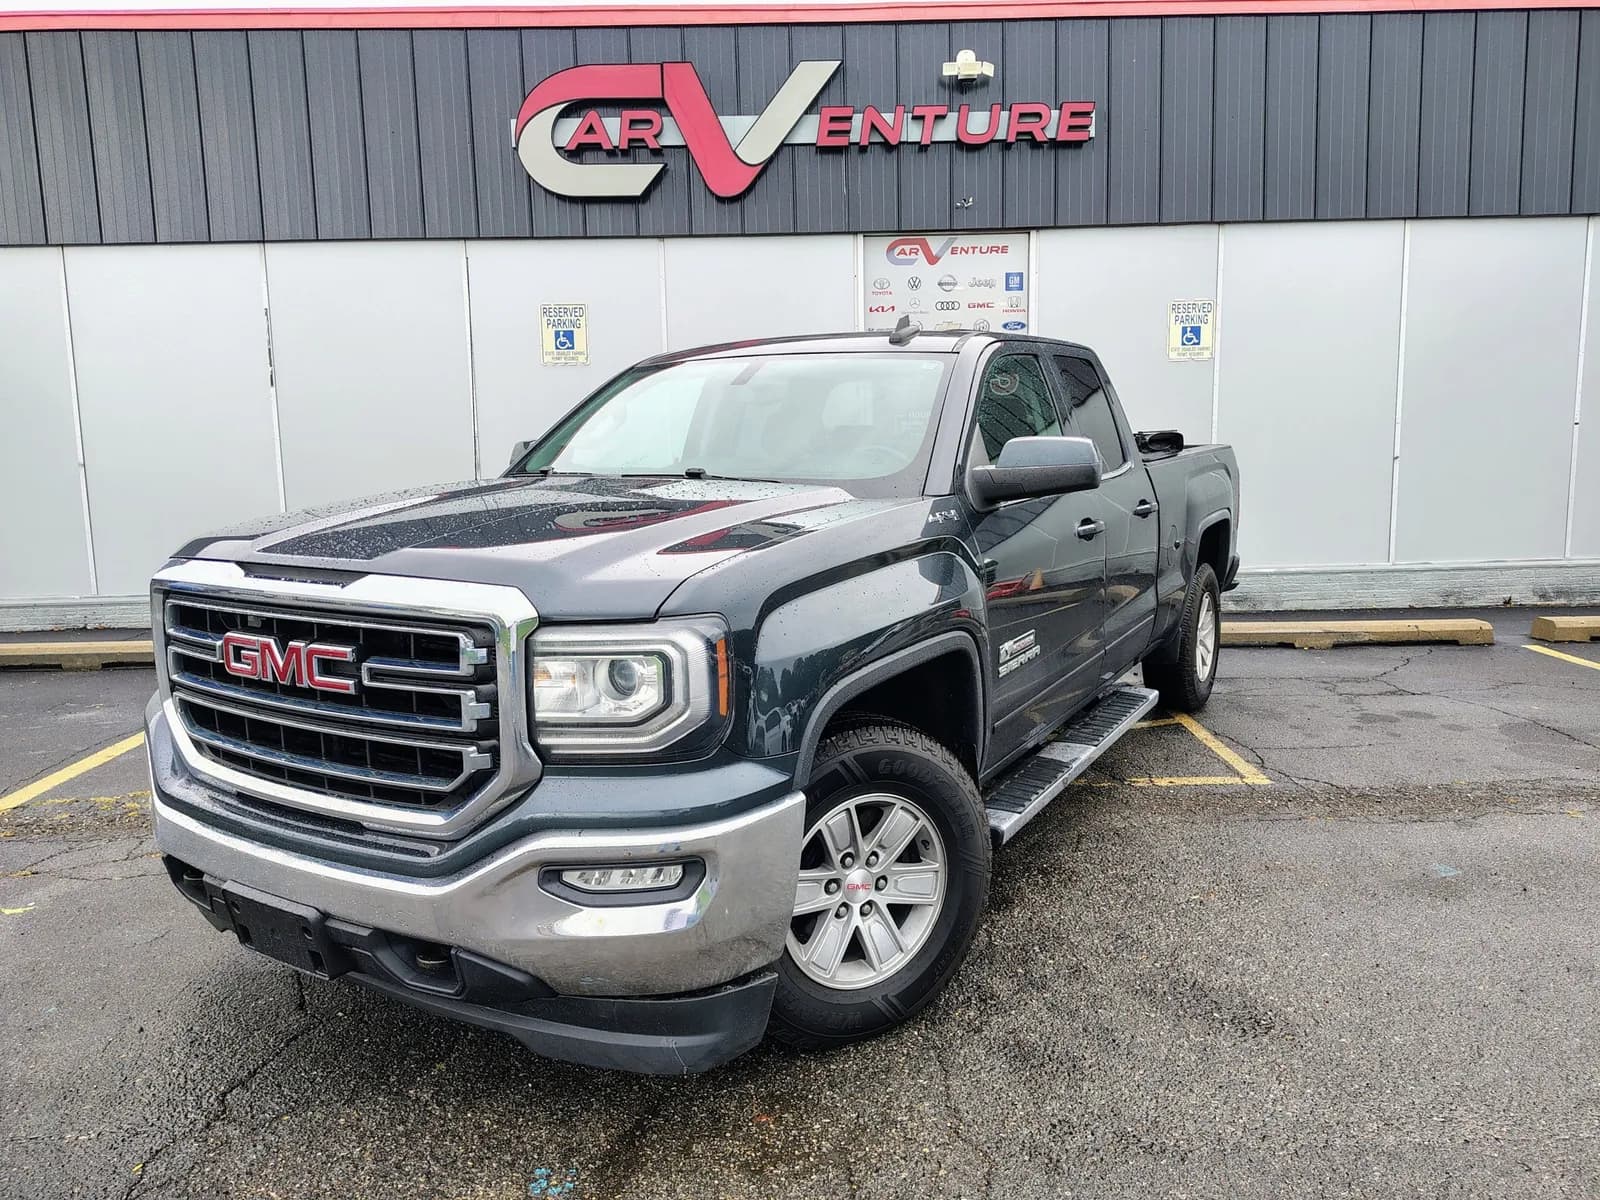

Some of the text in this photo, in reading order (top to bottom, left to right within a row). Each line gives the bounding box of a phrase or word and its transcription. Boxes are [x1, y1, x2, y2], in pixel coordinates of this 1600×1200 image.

[968, 276, 996, 288] Jeep
[542, 306, 585, 318] RESERVED
[1171, 302, 1213, 314] RESERVED
[546, 318, 582, 329] PARKING
[1174, 314, 1209, 325] PARKING
[223, 631, 356, 694] GMC
[998, 645, 1041, 679] SIERRA
[846, 882, 872, 891] GMC
